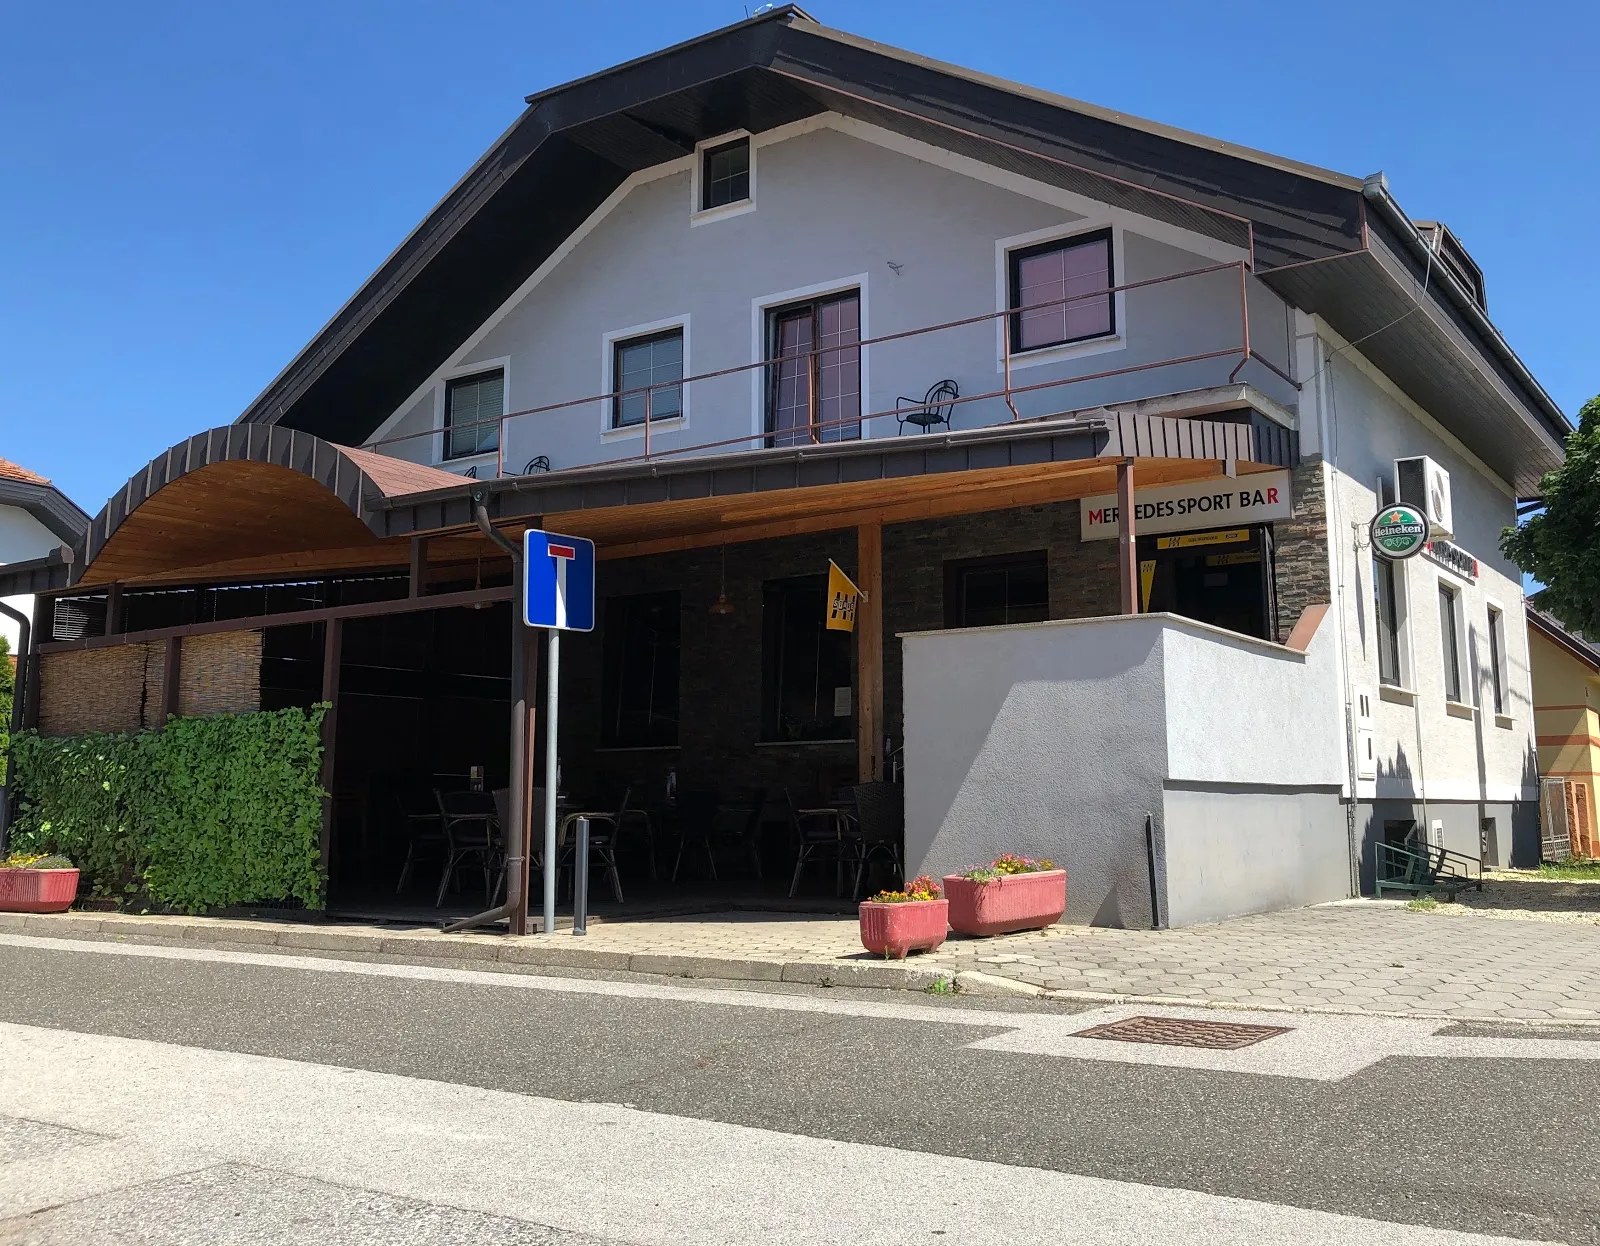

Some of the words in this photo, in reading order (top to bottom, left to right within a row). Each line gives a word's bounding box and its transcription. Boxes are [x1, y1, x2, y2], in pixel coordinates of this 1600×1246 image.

[1088, 500, 1174, 526] MEREDES
[1177, 493, 1234, 515] SPORT
[1239, 487, 1279, 508] BAR
[1374, 524, 1422, 537] Heineken
